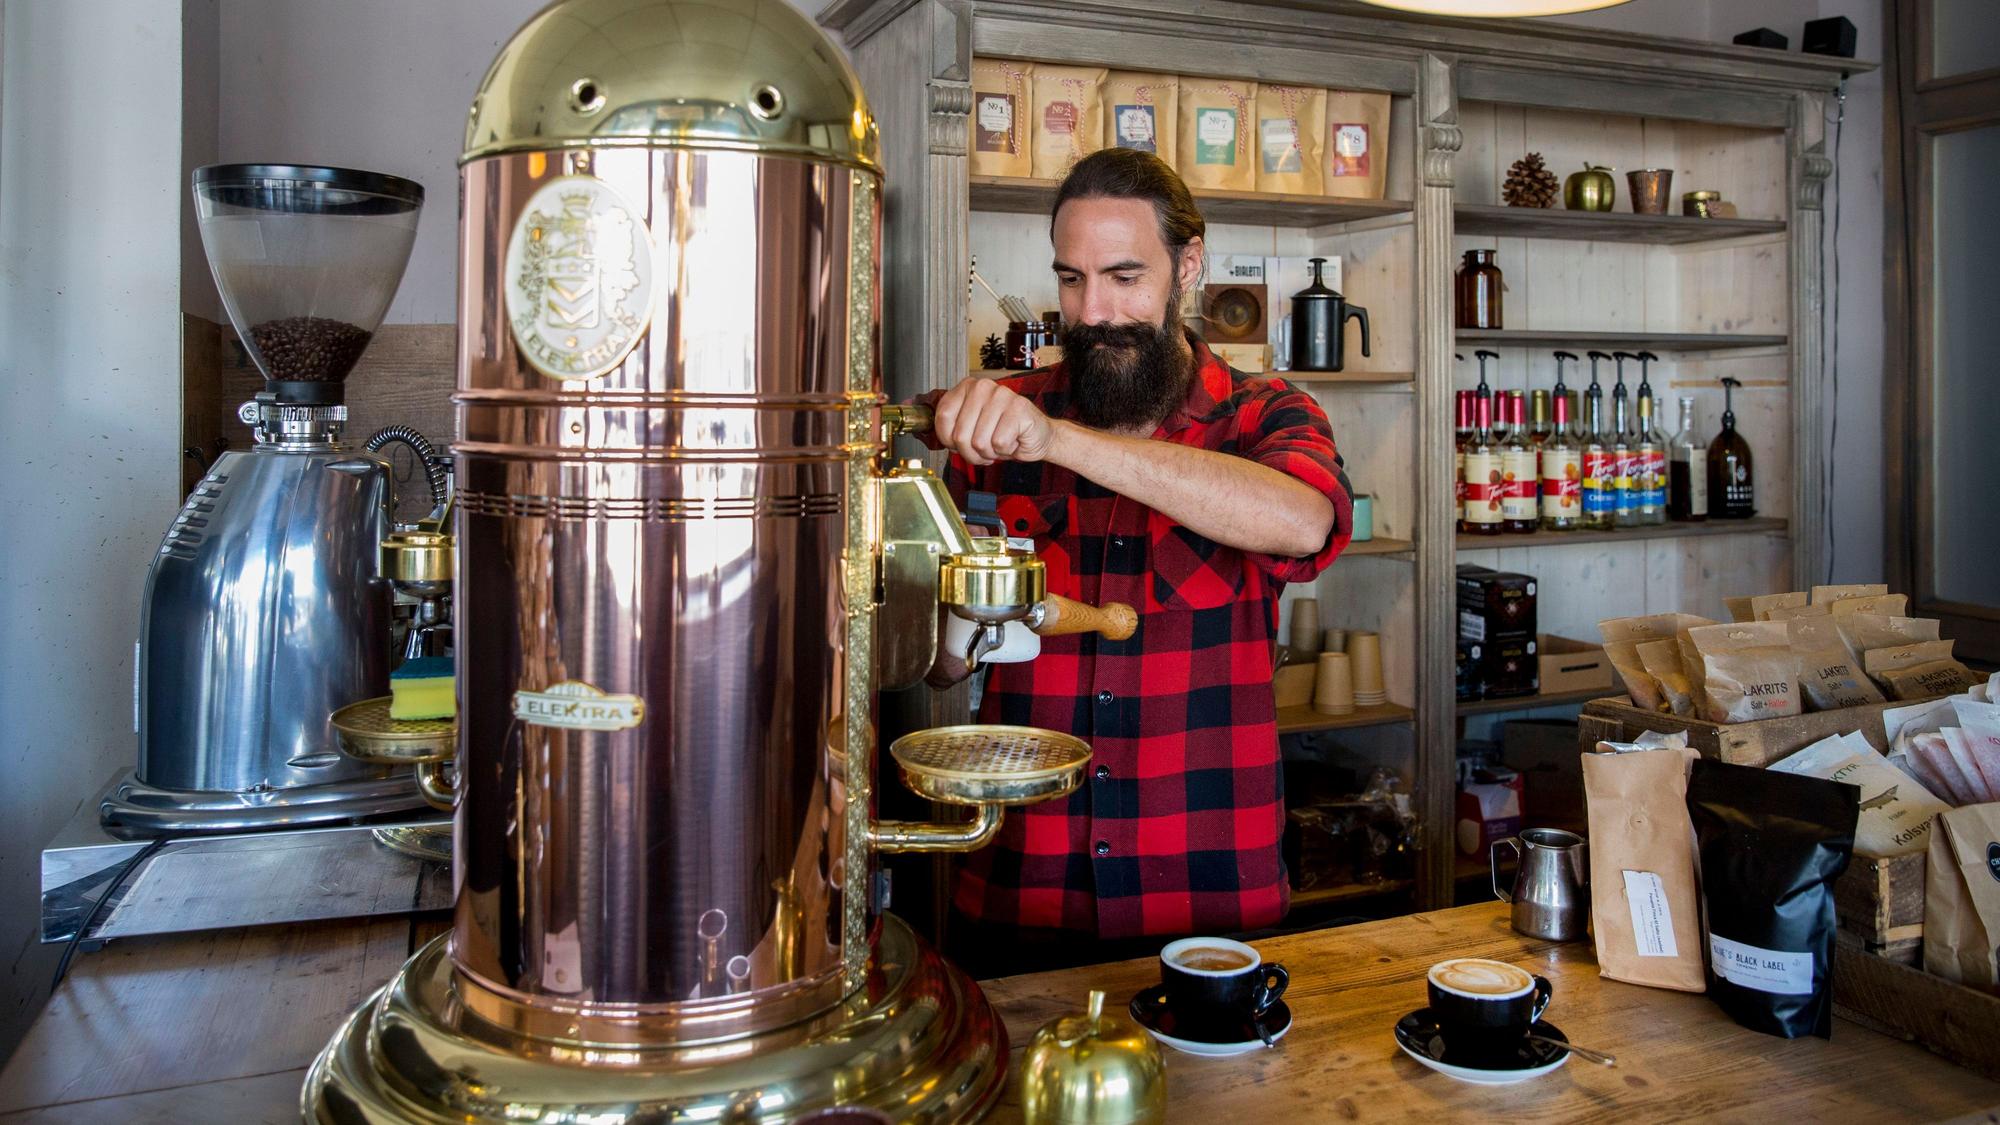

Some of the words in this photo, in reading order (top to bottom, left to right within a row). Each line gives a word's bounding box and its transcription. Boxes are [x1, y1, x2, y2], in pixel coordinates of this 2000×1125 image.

[1234, 265, 1262, 277] BIALETTI
[1743, 682, 1789, 697] LAKRITS
[527, 700, 624, 720] ELEKTRA
[1750, 700, 1763, 710] Salt
[1892, 814, 1934, 847] Kolsva
[1735, 953, 1758, 967] BLACK
[1762, 959, 1787, 972] LABEL
